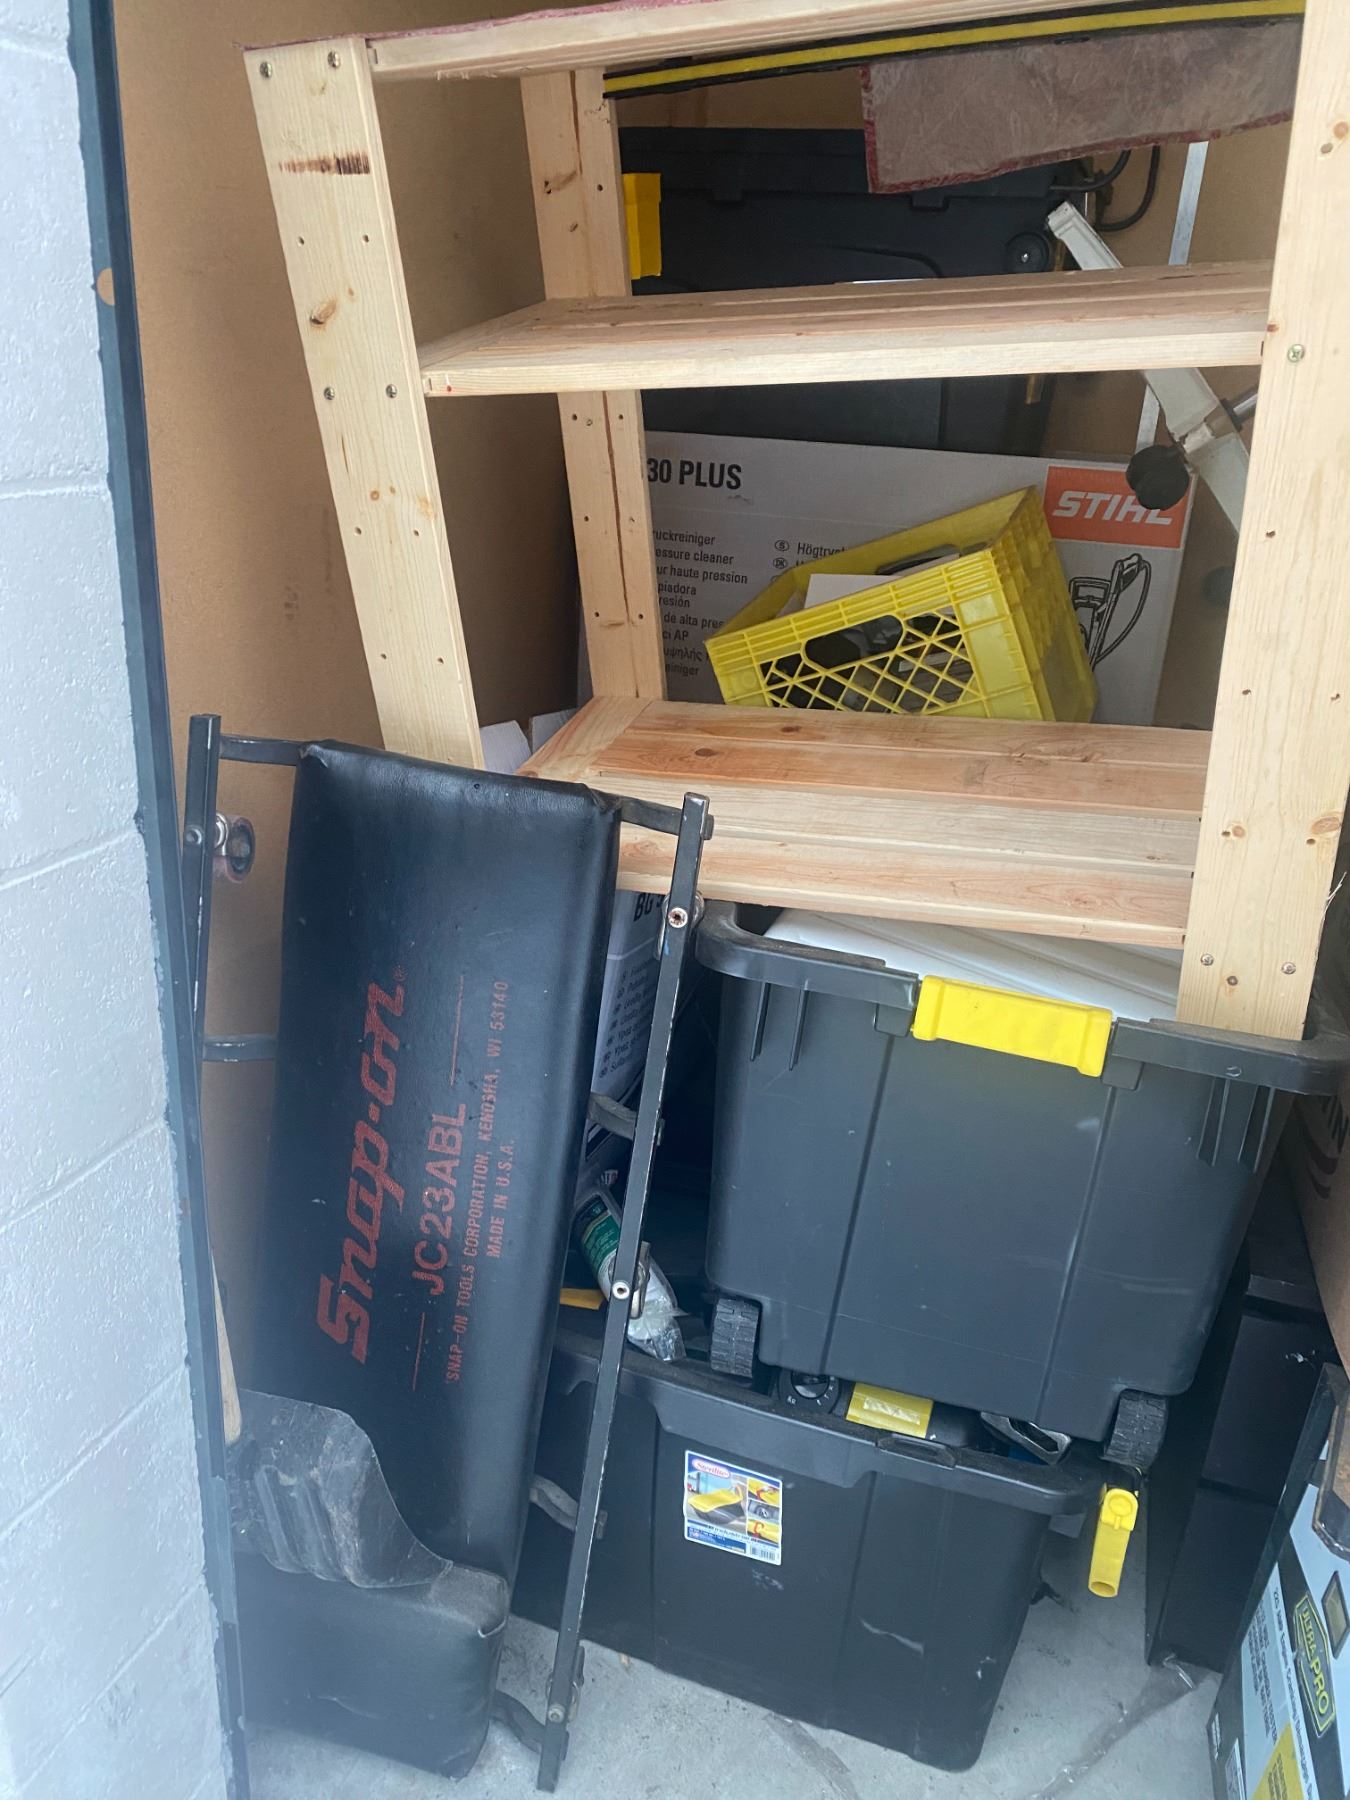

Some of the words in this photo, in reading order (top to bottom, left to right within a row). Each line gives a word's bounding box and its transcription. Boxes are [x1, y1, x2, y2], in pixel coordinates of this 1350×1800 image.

[679, 460, 742, 490] PLUS
[669, 565, 699, 578] haute
[702, 570, 748, 585] pression
[693, 551, 735, 565] cleaner
[657, 581, 697, 596] piadora
[663, 612, 677, 624] de
[679, 614, 698, 626] alta
[673, 629, 689, 641] AP
[490, 981, 509, 1031] 53140
[487, 1038, 502, 1057] WI
[478, 1069, 501, 1142] KENOSHA,
[315, 982, 406, 1365] Snap-on
[496, 1139, 515, 1187] U.S.A.
[412, 1103, 467, 1296] JC23ABL
[464, 1150, 492, 1257] CORPORATION,
[494, 1194, 509, 1210] IN
[487, 1216, 505, 1258] MADE
[457, 1264, 475, 1307] TOOLS
[446, 1314, 468, 1384] SNAP-ON
[1310, 1656, 1330, 1715] PRO
